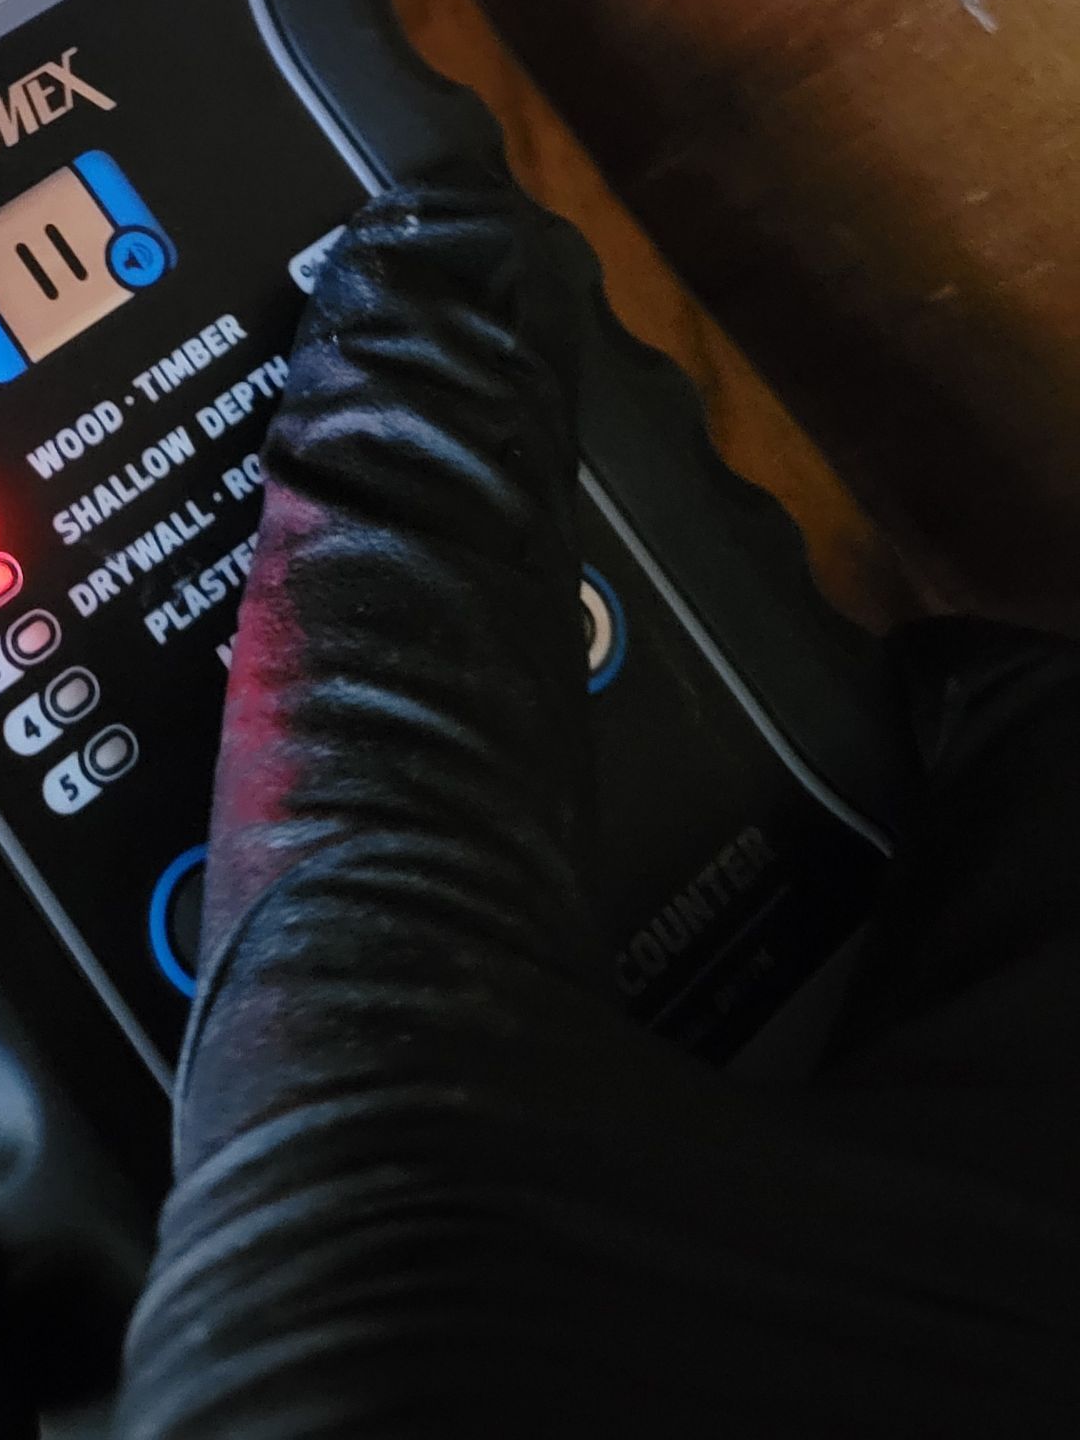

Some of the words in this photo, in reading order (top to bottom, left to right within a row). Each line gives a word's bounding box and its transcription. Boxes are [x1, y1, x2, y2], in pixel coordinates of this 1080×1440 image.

[26, 400, 125, 480] WOOD
[131, 313, 249, 404] TIMBER
[52, 425, 197, 546] SHALLOW
[195, 355, 290, 441] DEPTH
[68, 499, 215, 618] DRYWALL
[144, 532, 260, 645] PLASTE
[23, 714, 43, 739] 4
[58, 774, 81, 802] 5
